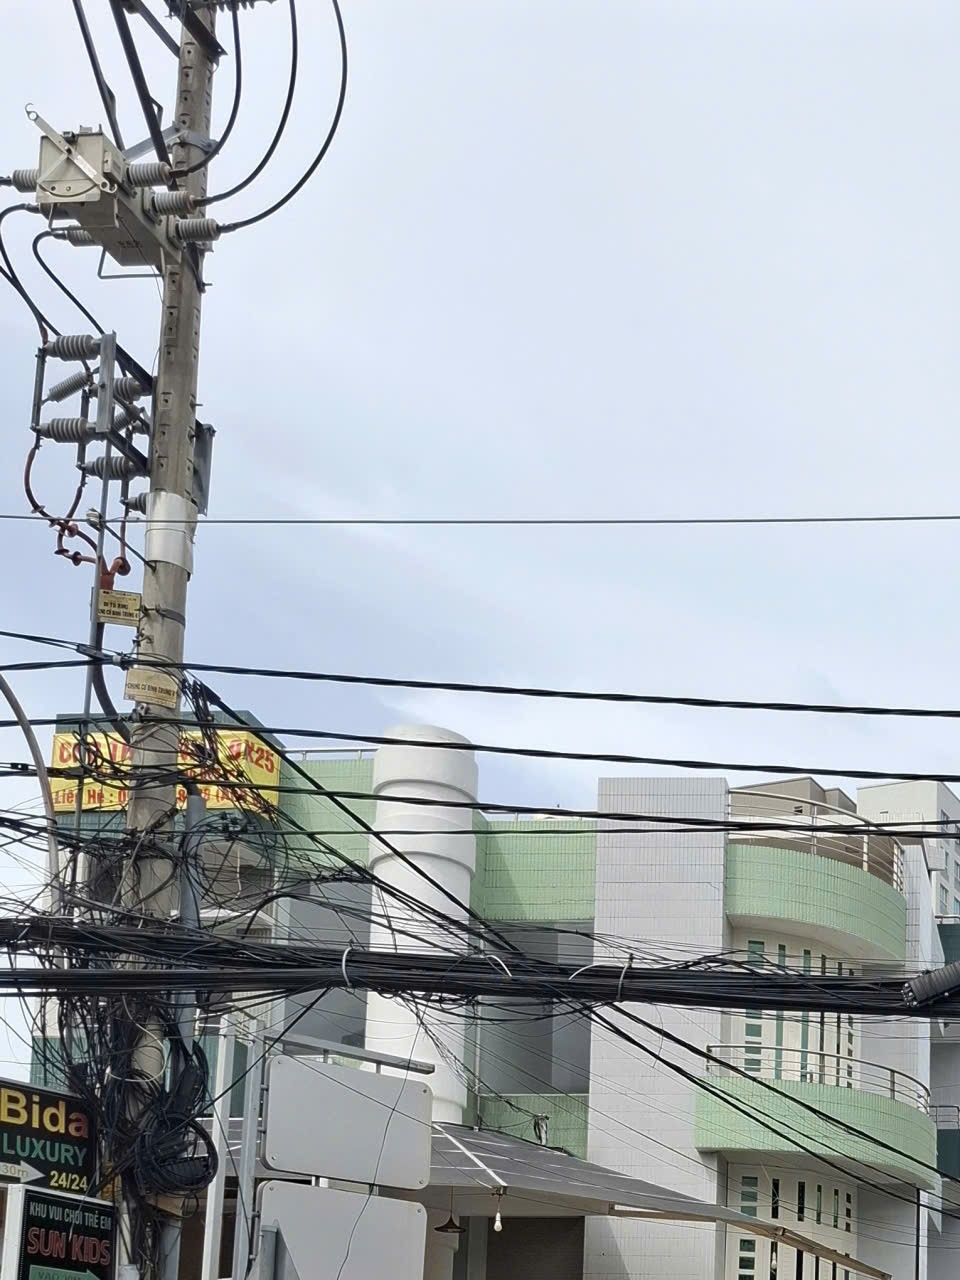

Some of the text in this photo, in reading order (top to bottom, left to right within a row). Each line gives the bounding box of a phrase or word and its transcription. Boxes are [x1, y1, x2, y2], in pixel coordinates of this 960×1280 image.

[0, 1087, 89, 1138] Bida
[2, 1132, 87, 1167] LUXURY
[49, 1170, 88, 1191] 24/24
[29, 1201, 112, 1231] KHU VUI CHƠI TRẺ EM
[27, 1226, 112, 1266] SUN KIDS
